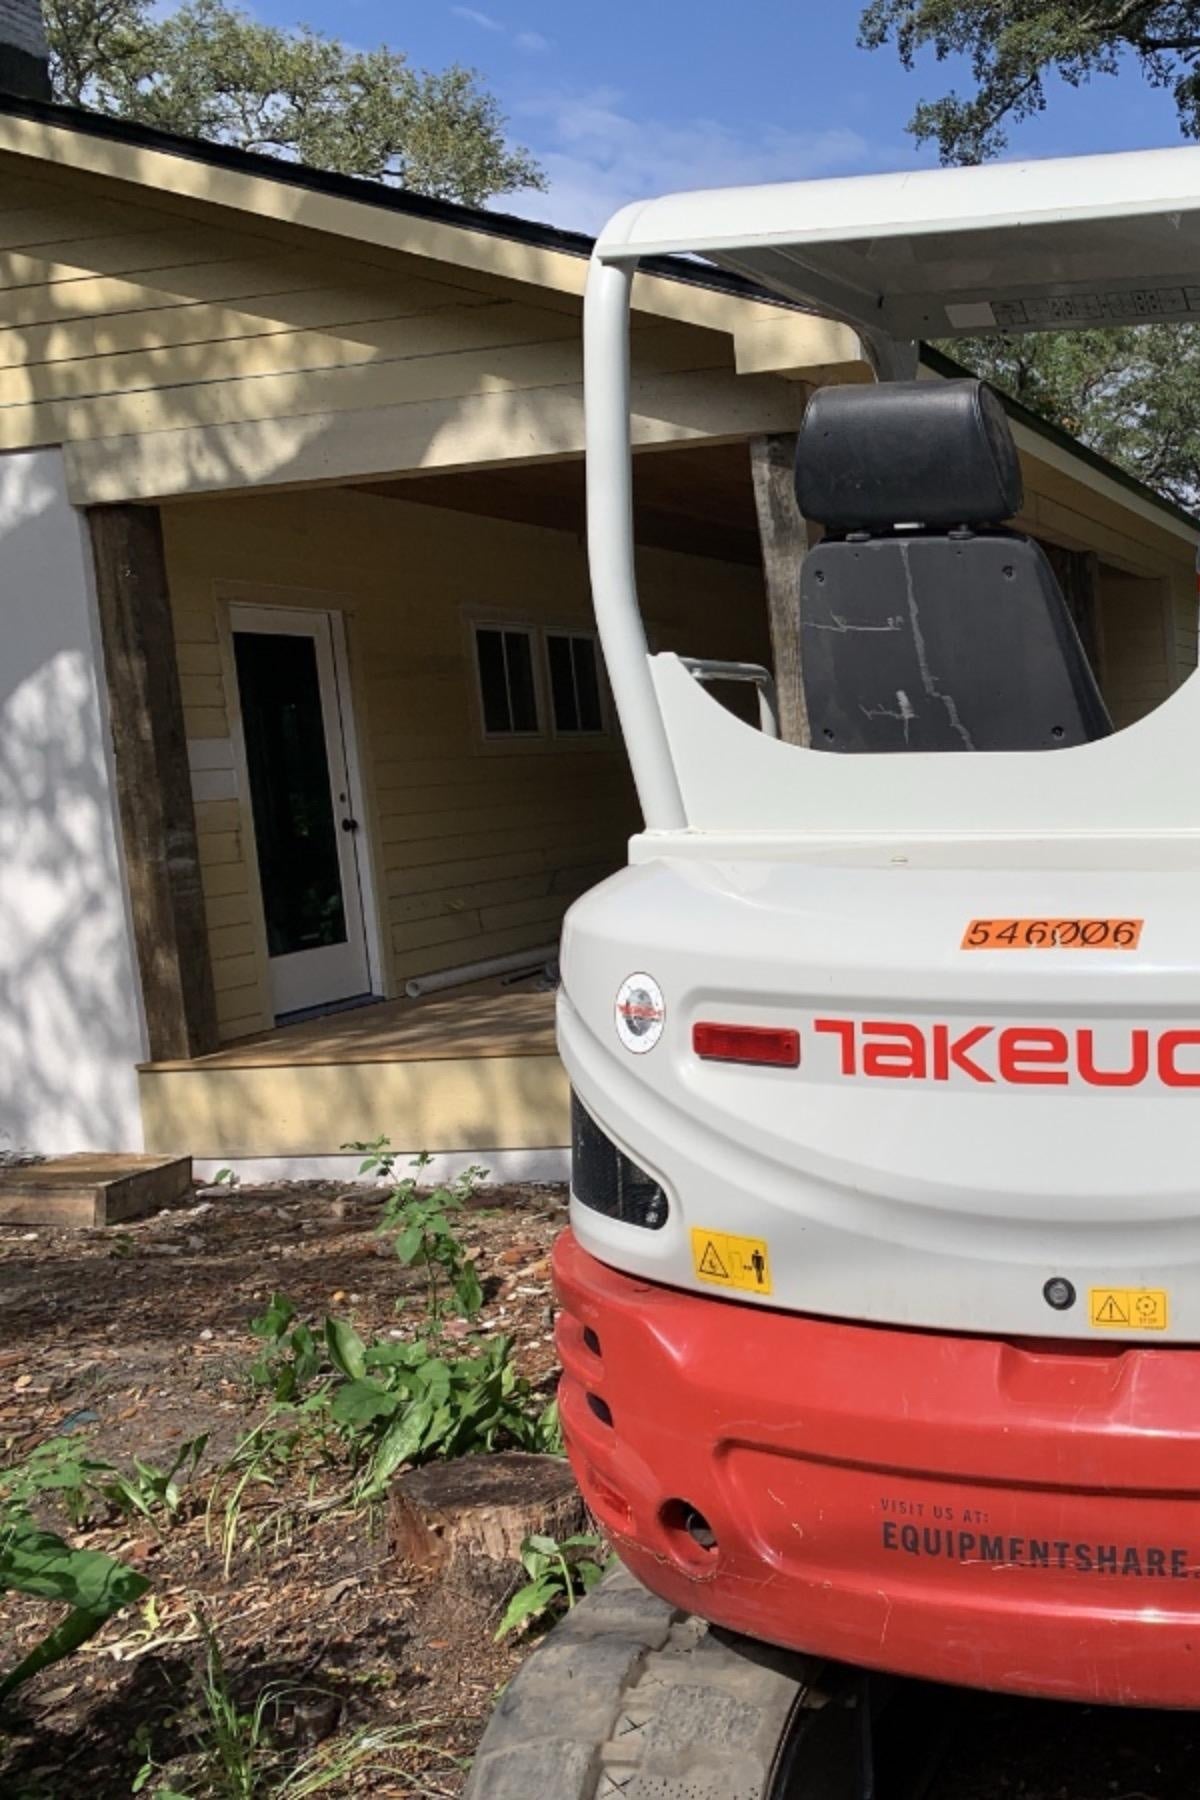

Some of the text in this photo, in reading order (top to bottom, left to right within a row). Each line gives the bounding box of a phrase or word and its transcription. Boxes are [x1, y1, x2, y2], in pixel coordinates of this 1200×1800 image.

[967, 921, 1137, 946] 546006
[880, 1499, 989, 1523] VISIT US AT:
